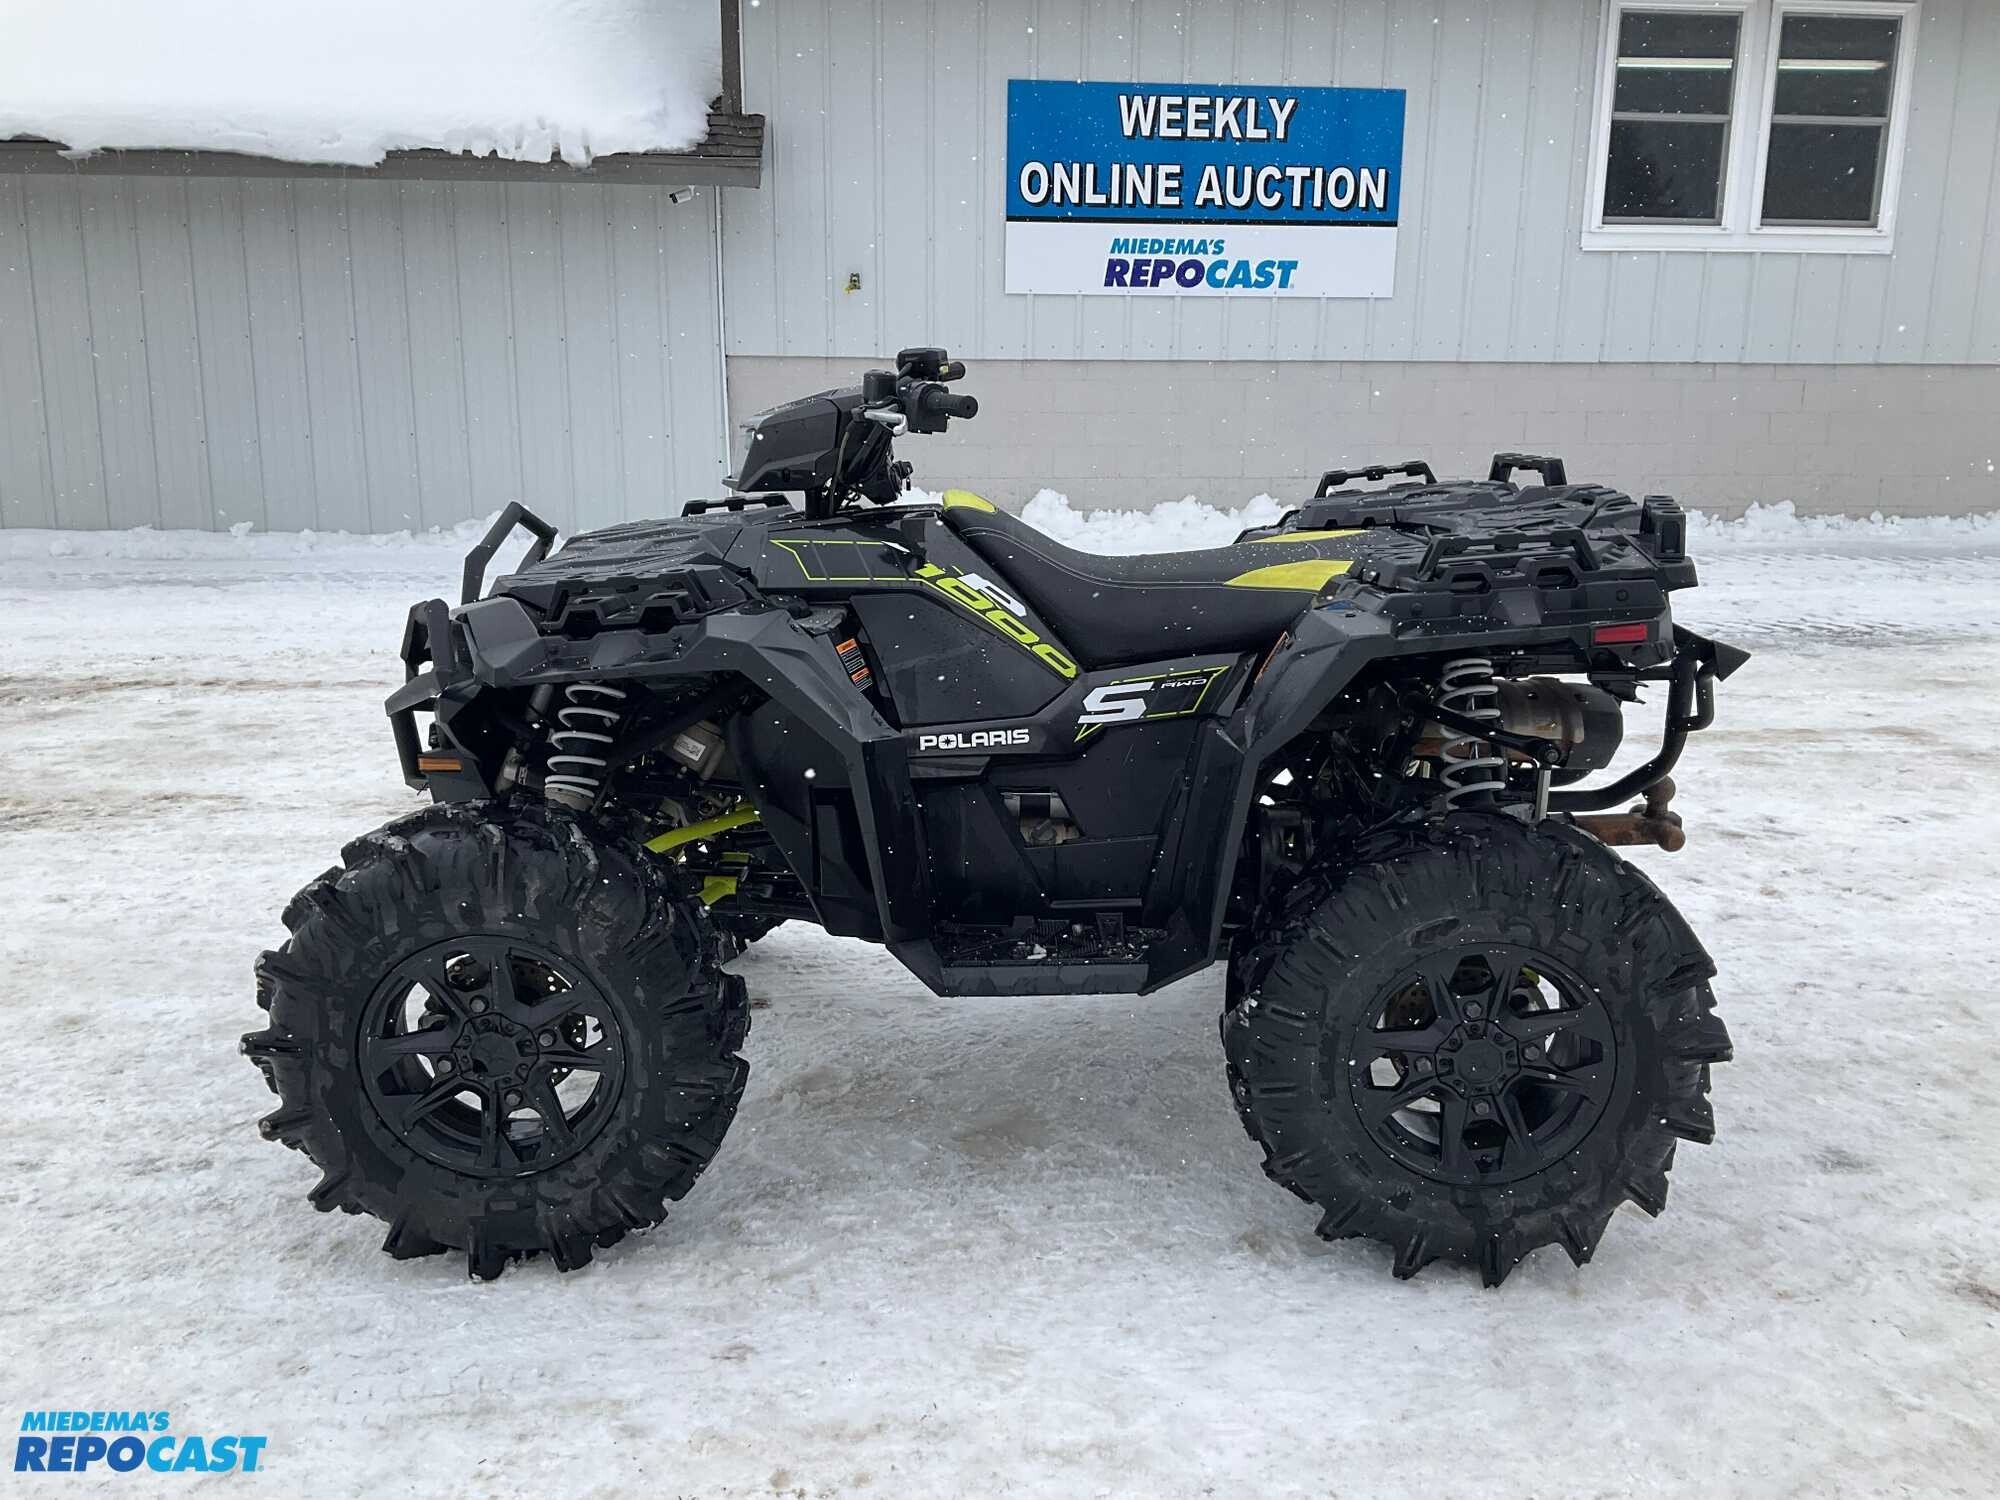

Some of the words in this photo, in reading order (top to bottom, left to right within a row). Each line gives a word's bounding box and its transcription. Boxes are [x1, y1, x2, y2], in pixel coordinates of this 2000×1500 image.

[1118, 94, 1296, 139] WEEKLY
[1019, 161, 1182, 206] ONLINE
[1194, 164, 1387, 209] AUCTION
[1110, 237, 1225, 256] MIEDEMA'S
[1103, 258, 1299, 289] REPOCAST
[1077, 681, 1155, 724] S
[919, 728, 1030, 751] POLARIS
